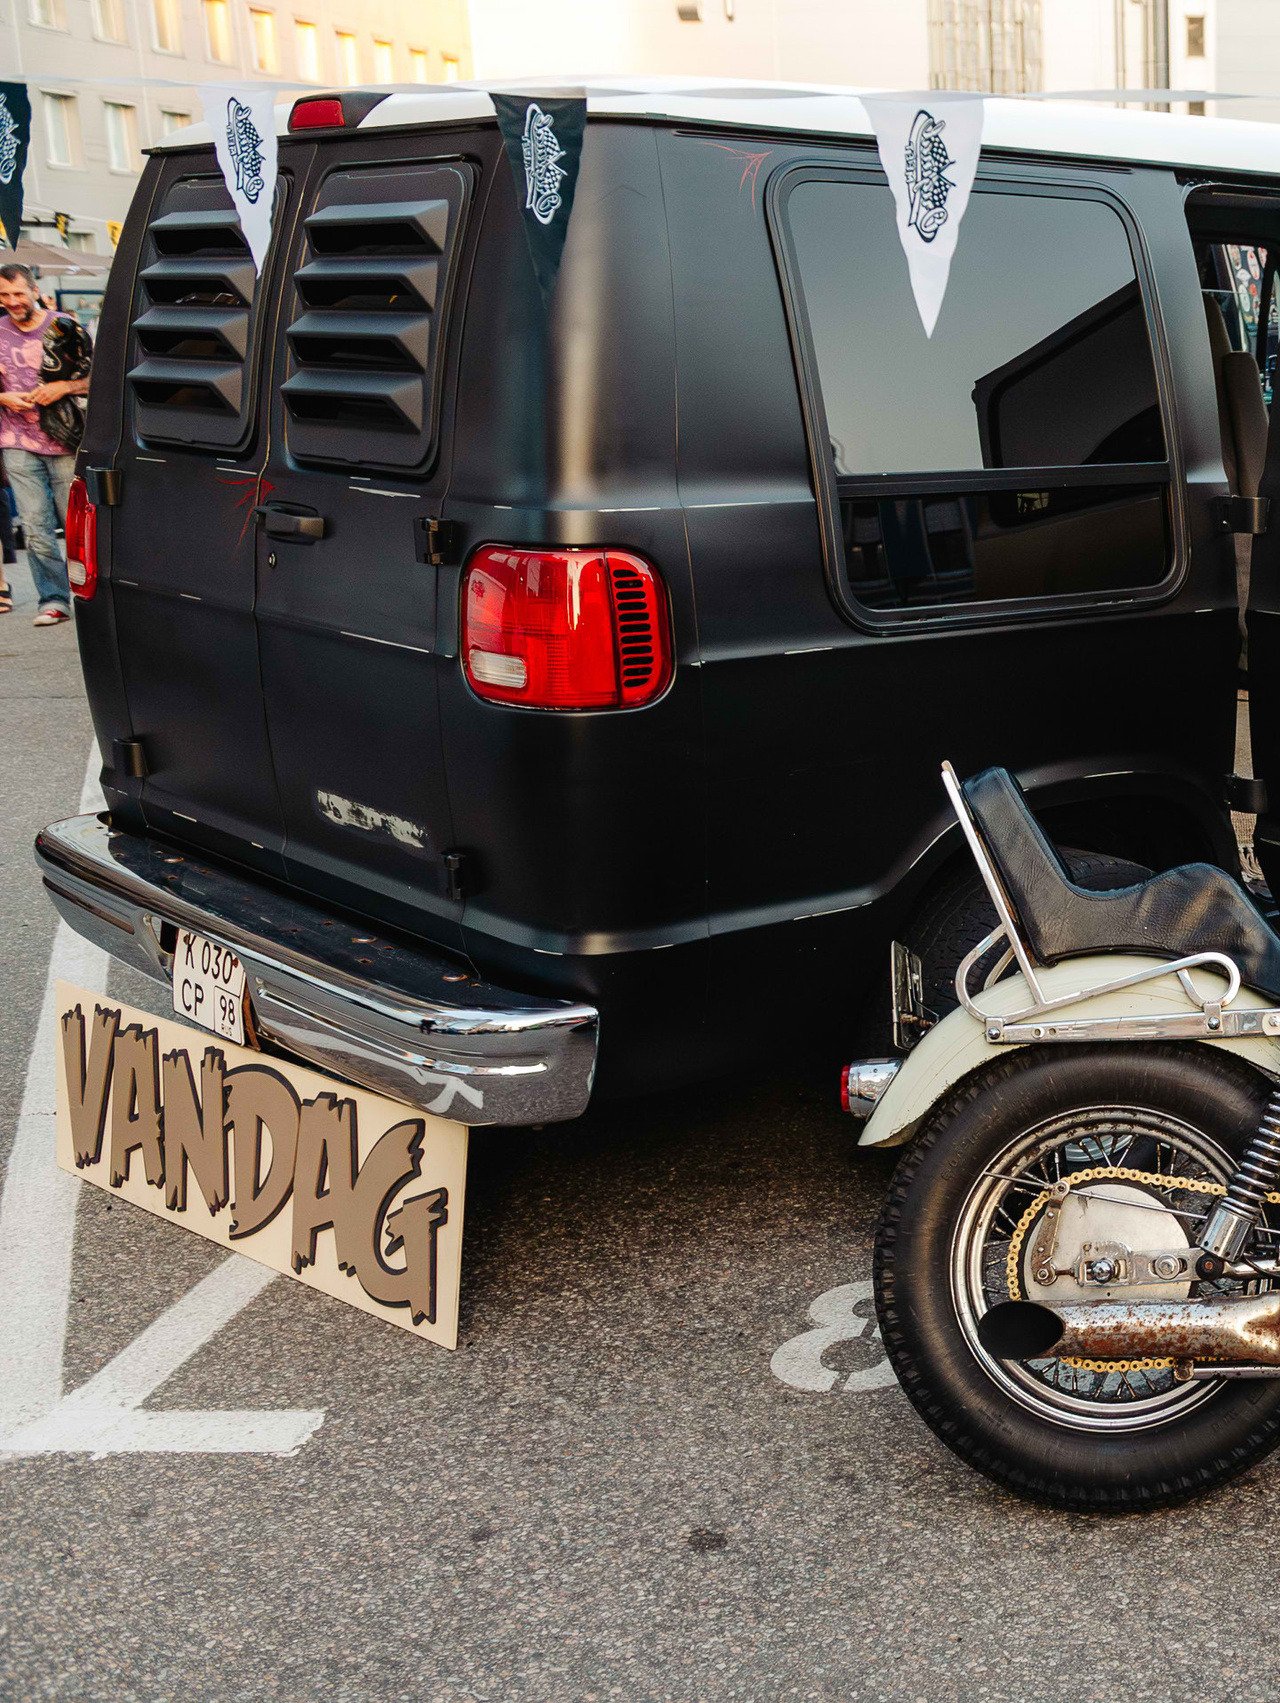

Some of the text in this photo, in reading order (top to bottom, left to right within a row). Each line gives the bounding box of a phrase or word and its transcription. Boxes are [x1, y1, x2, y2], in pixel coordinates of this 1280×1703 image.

[201, 941, 233, 985] 030
[219, 995, 235, 1026] 98
[61, 1003, 448, 1326] VANDAG
